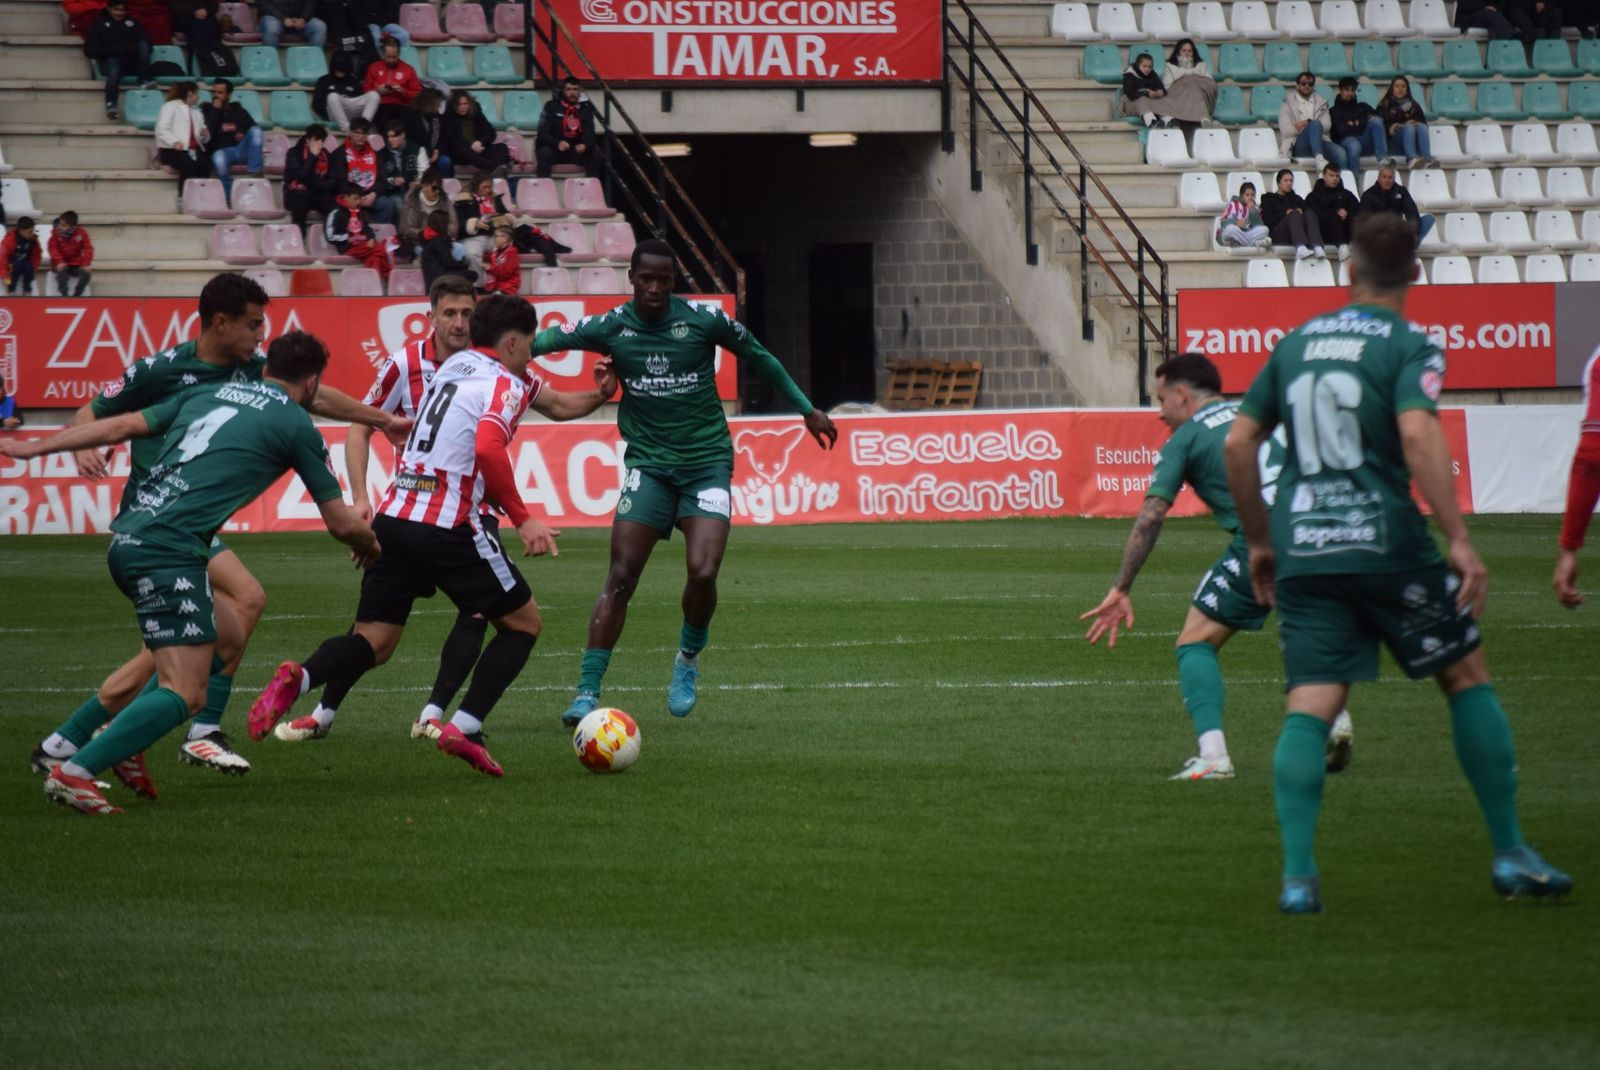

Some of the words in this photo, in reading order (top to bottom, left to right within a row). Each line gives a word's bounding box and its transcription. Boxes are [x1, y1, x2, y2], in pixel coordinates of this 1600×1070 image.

[652, 26, 840, 77] TAMAR,
[854, 57, 897, 76] S.A.
[178, 406, 239, 463] 4
[407, 383, 458, 454] 19
[1286, 371, 1363, 476] 16
[851, 423, 1063, 466] Escuela
[858, 470, 1064, 515] infantil
[1097, 474, 1119, 491] los
